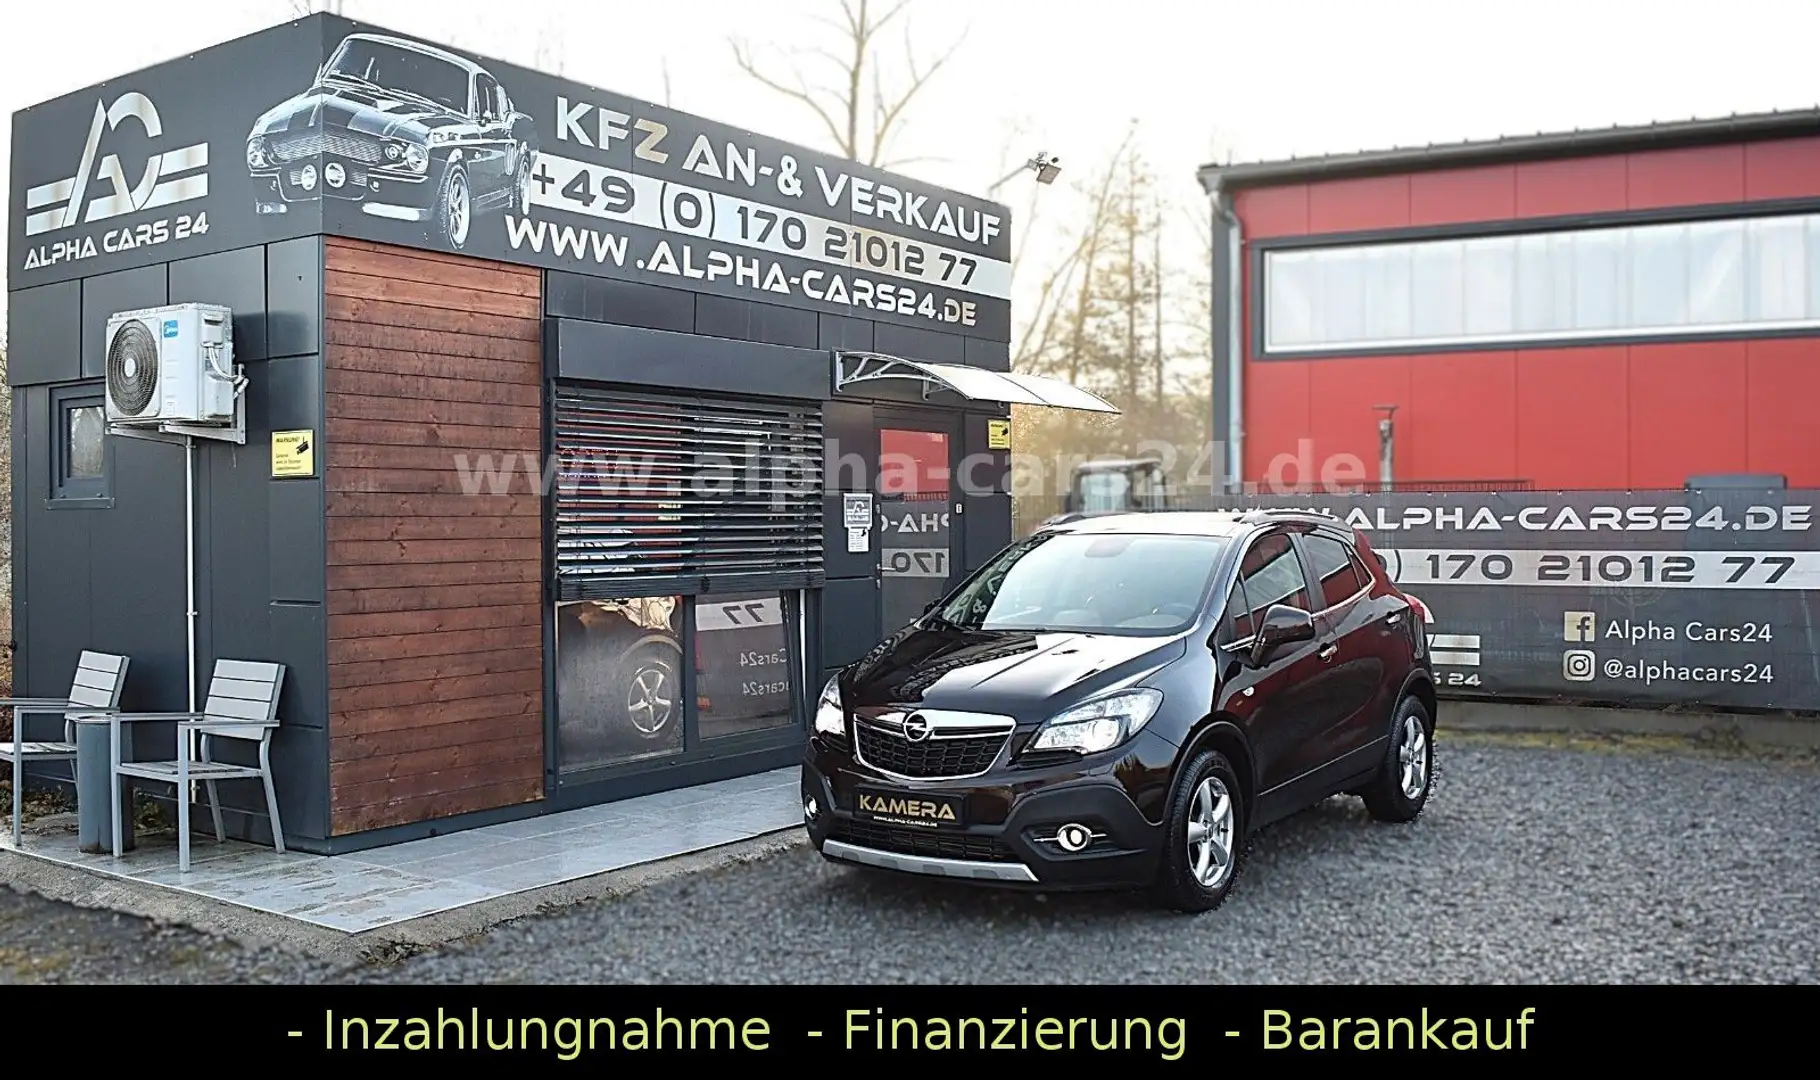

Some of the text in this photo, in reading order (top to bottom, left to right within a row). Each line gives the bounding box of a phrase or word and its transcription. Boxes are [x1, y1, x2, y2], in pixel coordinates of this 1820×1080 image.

[557, 96, 669, 164] KFZ
[814, 166, 1001, 245] VERKAUF
[532, 164, 977, 286] +49 (0) 170 21012 77
[24, 211, 209, 270] ALPHA CARS 24
[1217, 505, 1811, 532] ALPHA-CARS24.DE
[1426, 554, 1513, 582] 170
[1537, 555, 1696, 583] 21012
[1721, 556, 1795, 584] 77
[1605, 619, 1773, 646] Alpha Cars24
[1448, 672, 1482, 687] 24
[1603, 659, 1774, 686] @alphacars24
[859, 794, 956, 820] KAMERA
